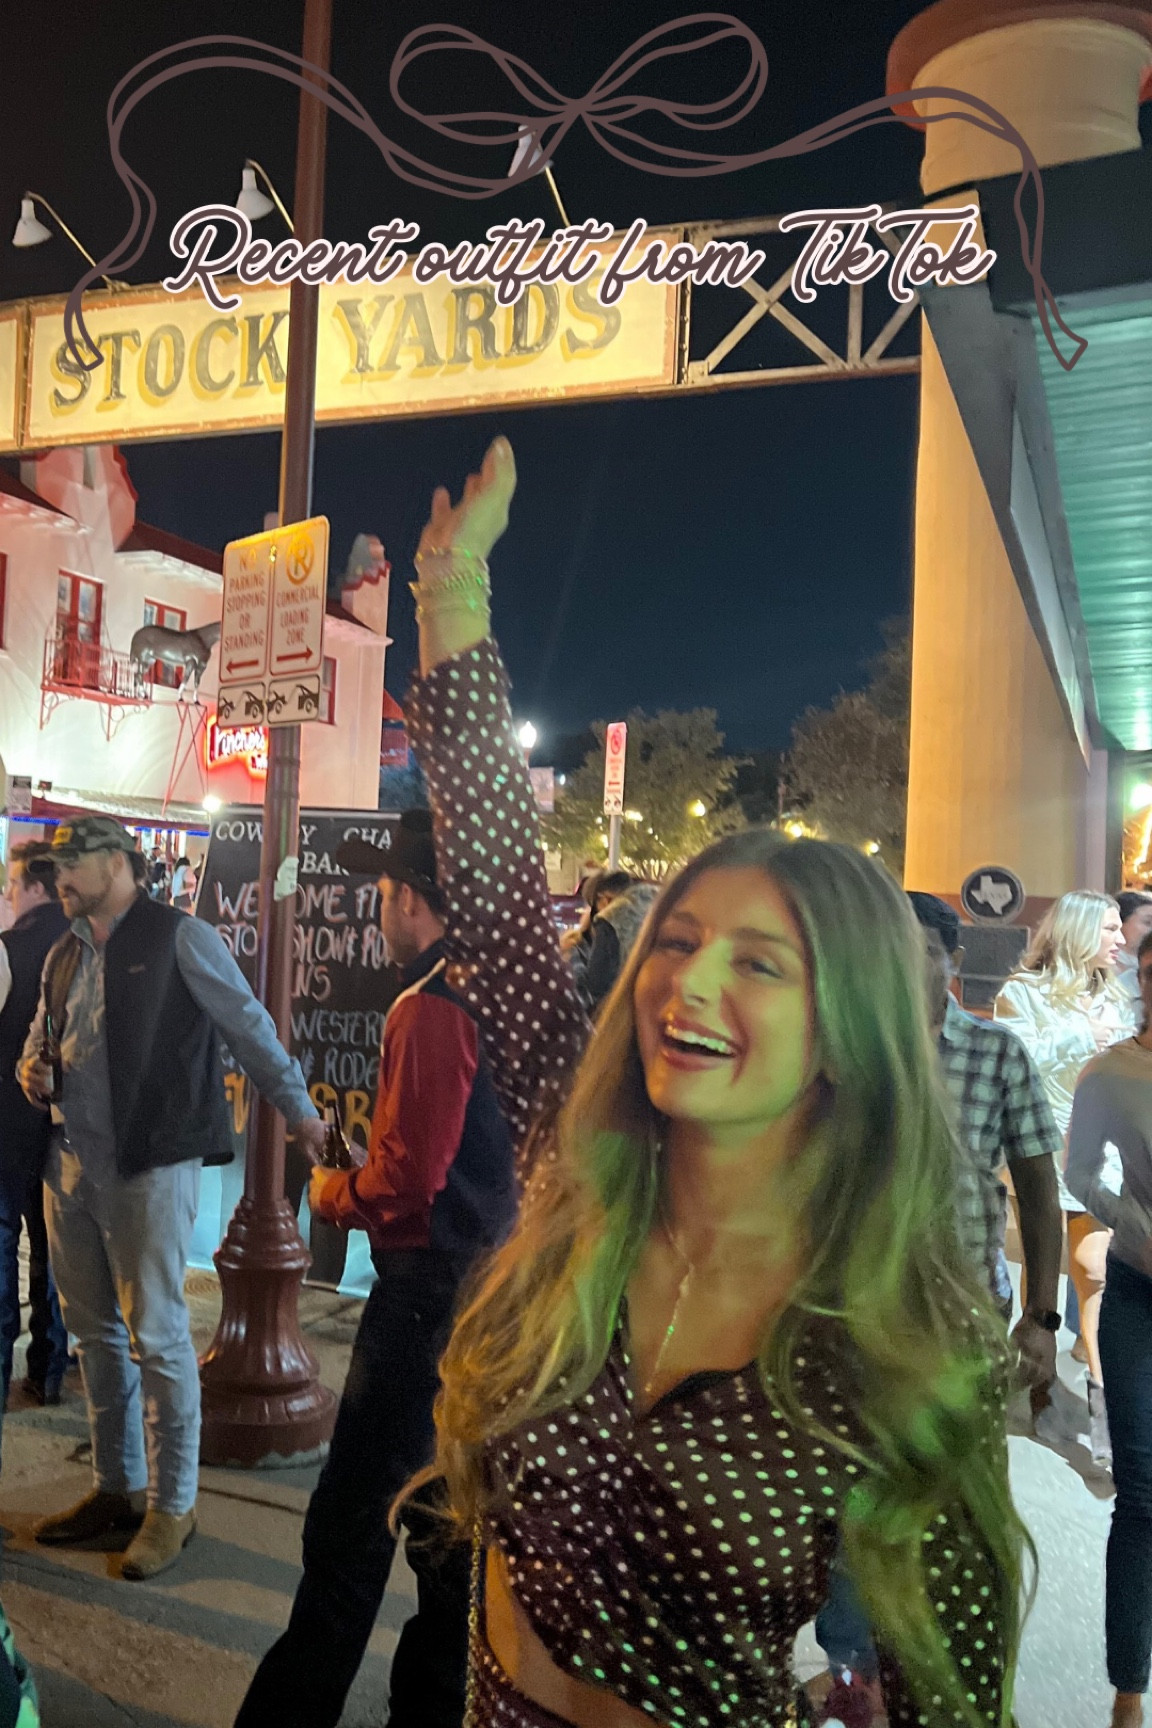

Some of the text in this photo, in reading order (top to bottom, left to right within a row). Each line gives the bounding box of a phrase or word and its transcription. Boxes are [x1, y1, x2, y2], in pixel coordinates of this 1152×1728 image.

[51, 266, 623, 414] STOCK YARDS
[239, 548, 257, 571] NO
[229, 571, 265, 592] PARKING
[226, 591, 266, 613] STOPPING
[276, 584, 319, 608] COMMERCIAL
[239, 613, 250, 630] OR
[280, 607, 309, 628] LOADING
[225, 630, 264, 652] STANDING
[287, 628, 304, 646] ZONE
